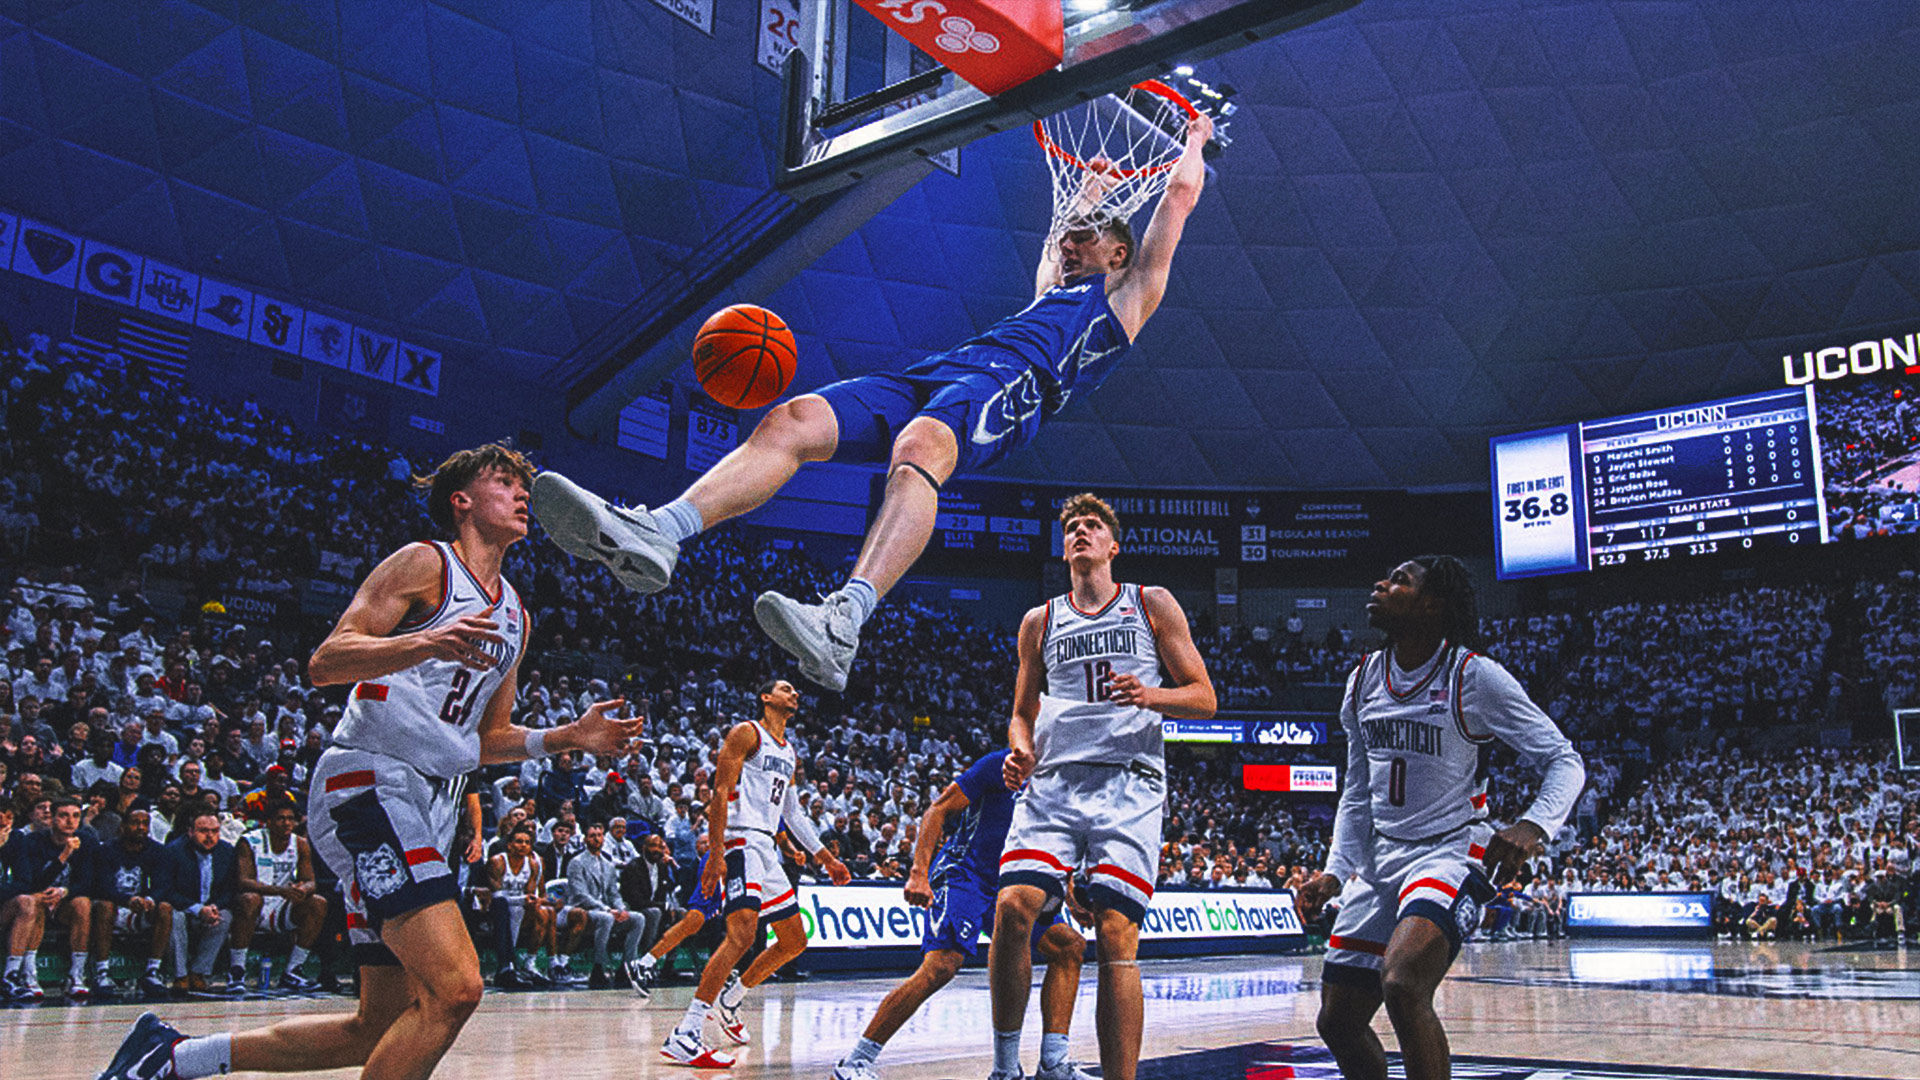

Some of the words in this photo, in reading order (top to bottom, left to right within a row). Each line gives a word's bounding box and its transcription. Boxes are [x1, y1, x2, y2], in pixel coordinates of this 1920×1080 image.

[85, 252, 133, 298] G
[356, 337, 394, 374] V
[1783, 333, 1920, 385] UCON
[402, 351, 436, 390] X
[697, 416, 729, 440] 873
[1656, 406, 1726, 430] UCONN
[1594, 455, 1601, 463] 0
[1723, 435, 1731, 443] 0
[1746, 432, 1750, 441] 1
[1766, 428, 1775, 437] 0
[1789, 425, 1797, 433] 0
[1724, 446, 1732, 454] 0
[1745, 443, 1753, 451] 0
[1768, 440, 1776, 448] 0
[1790, 436, 1798, 445] 0
[1747, 454, 1754, 463] 0
[1769, 451, 1776, 459] 0
[1791, 448, 1799, 456] 0
[1748, 466, 1755, 474] 0
[1792, 459, 1800, 467] 0
[1749, 477, 1756, 485] 0
[1771, 474, 1778, 482] 0
[1793, 471, 1801, 479] 0
[1160, 498, 1230, 517] BASKETBALL
[1505, 493, 1569, 522] 36.8
[1669, 503, 1697, 514] TEAM
[1700, 499, 1731, 511] STATS
[1269, 529, 1322, 539] REGULAR
[1324, 528, 1370, 539] SEASON
[1607, 533, 1615, 543] 7
[1659, 527, 1666, 536] 7
[1697, 522, 1705, 531] 8
[1743, 516, 1749, 526] 1
[1786, 510, 1796, 520] 0
[1270, 548, 1348, 559] TOURNAMENT
[1599, 553, 1626, 566] 52.9
[1644, 548, 1670, 561] 37.5
[1690, 542, 1718, 555] 33.3
[1742, 538, 1752, 548] 0
[1789, 532, 1799, 543] 0
[222, 595, 276, 616] UCONN
[1056, 630, 1138, 664] CONNECTICUT
[1389, 756, 1407, 807] 0
[1202, 899, 1297, 932] biohaven
